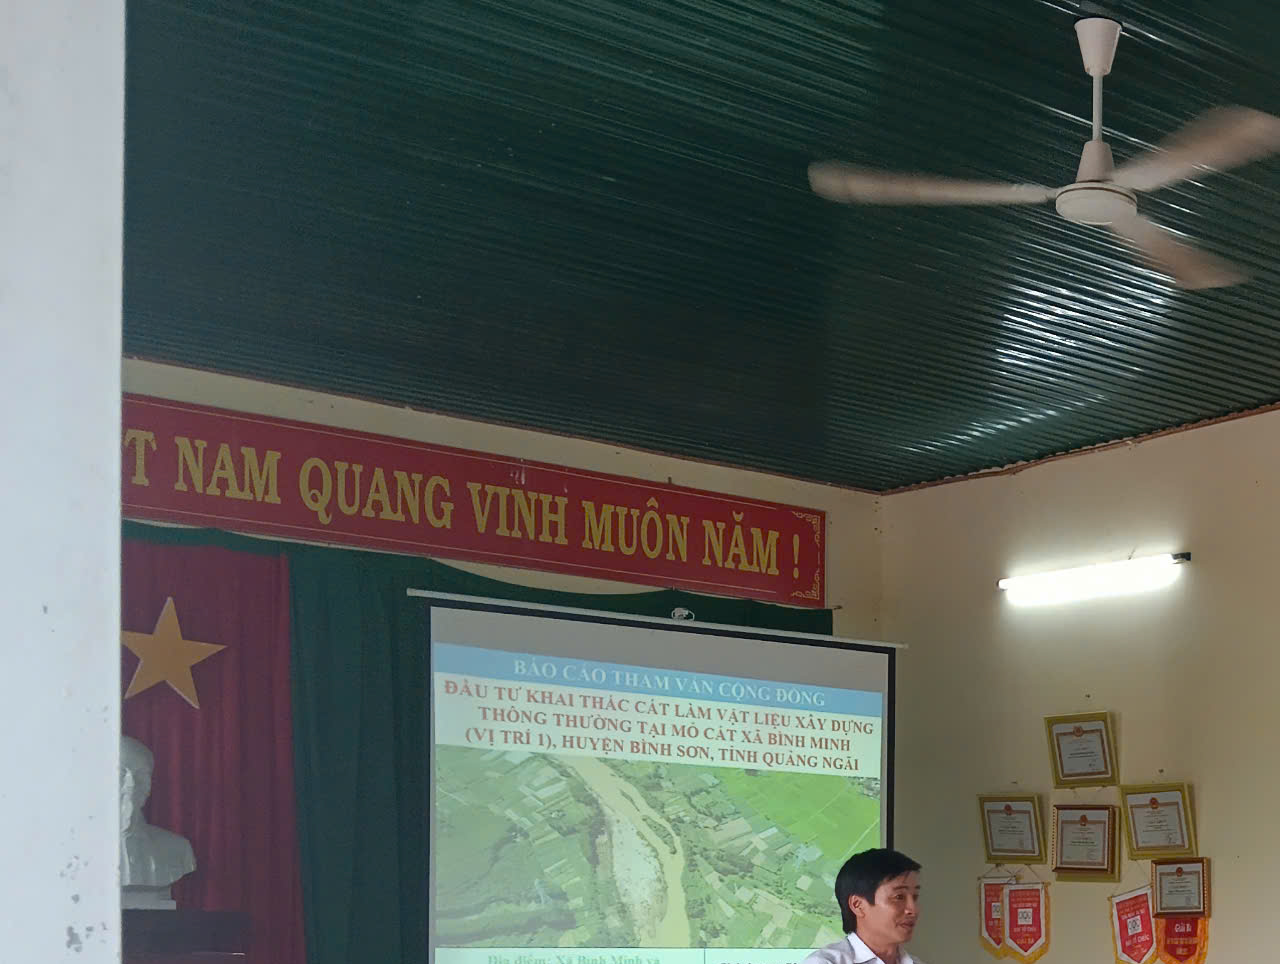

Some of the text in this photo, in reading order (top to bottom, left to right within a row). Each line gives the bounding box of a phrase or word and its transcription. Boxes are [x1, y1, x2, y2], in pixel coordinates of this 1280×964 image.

[174, 436, 281, 504] NAM
[299, 457, 454, 528] QUANG
[467, 482, 568, 545] VINH
[582, 497, 689, 562] MUÔN
[702, 511, 779, 576] NĂM
[611, 670, 670, 690] THAM
[719, 680, 770, 702] CỘNG
[479, 704, 547, 725] THÔNG
[553, 712, 632, 734] THƯỜNG
[637, 720, 666, 739] TẠI
[704, 724, 736, 742] CÁT
[741, 728, 763, 745] XÃ
[768, 731, 805, 748] BÌNH
[810, 736, 850, 752] MINH
[494, 685, 523, 702] TƯ
[526, 689, 574, 707] KHAI
[579, 693, 629, 712] THÁC
[634, 697, 670, 716] CÁT
[675, 702, 711, 720] LÀM
[716, 705, 750, 726] VẬT
[754, 710, 791, 729] LIỆU
[795, 713, 826, 731] XÂY
[831, 719, 874, 736] DỰNG
[465, 726, 859, 771] (VỊ TRÍ 1), HUYỆN BÌNH SƠN, TỈNH QUẢNG NGÃI
